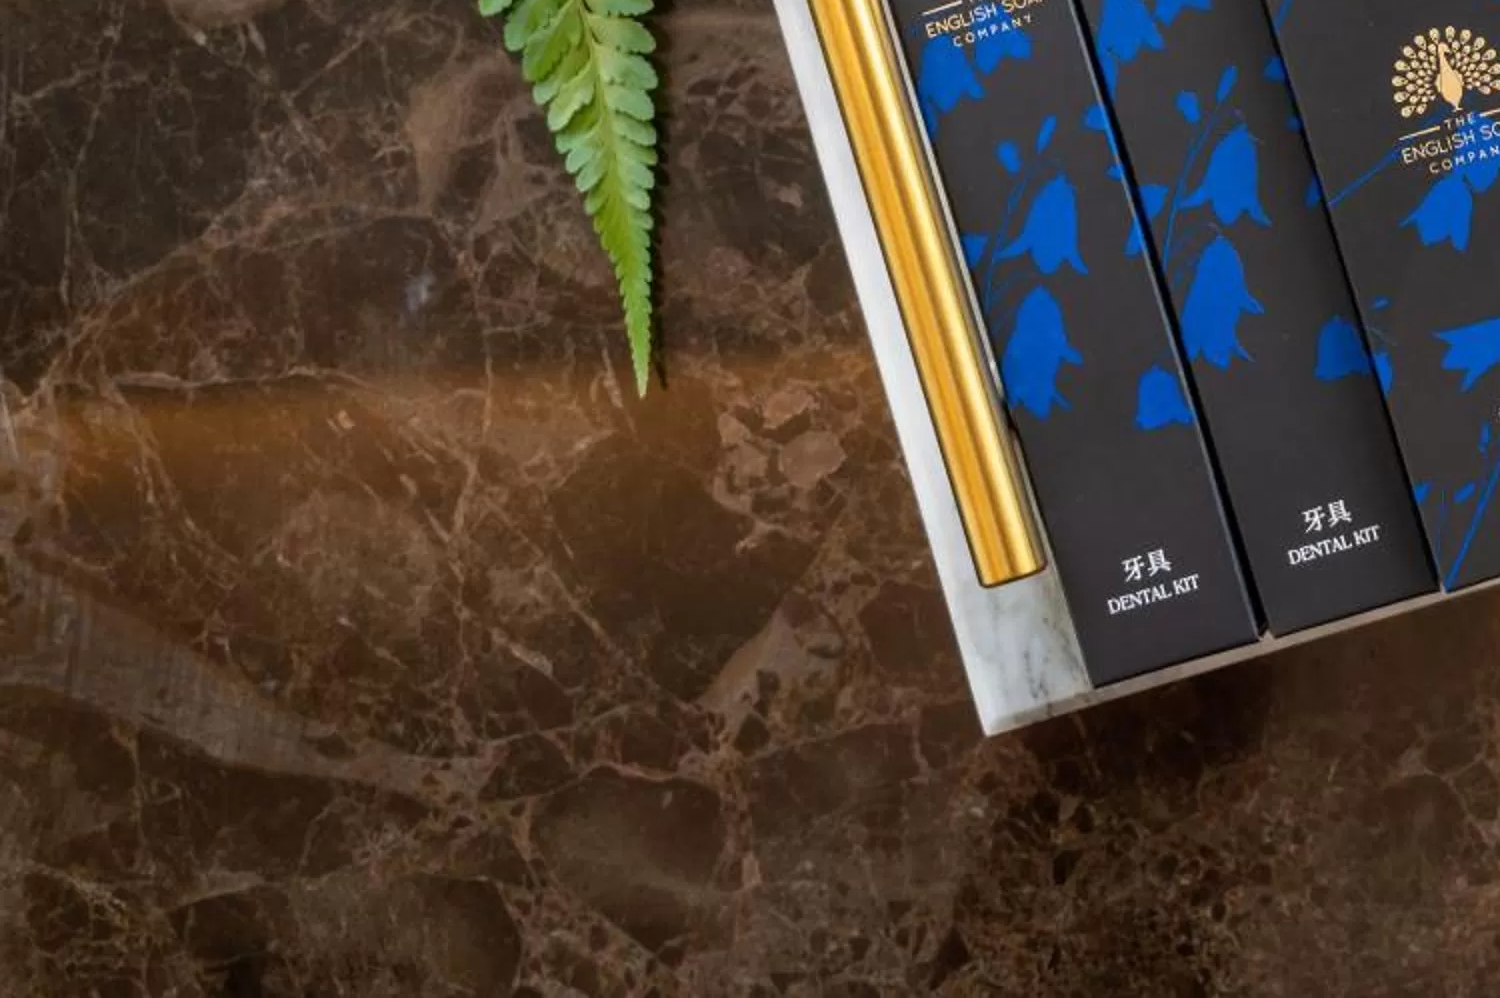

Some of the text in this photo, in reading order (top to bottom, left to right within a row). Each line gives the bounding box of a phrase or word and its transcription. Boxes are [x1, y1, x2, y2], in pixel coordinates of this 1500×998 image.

[925, 4, 997, 38] ENGLISH
[953, 13, 1032, 47] COMPANY
[1444, 112, 1476, 130] THE
[1402, 130, 1475, 164] ENGLISH
[1302, 499, 1352, 533] 牙具
[1288, 524, 1380, 565] DENTAL KIT
[1121, 549, 1171, 582] 牙具
[1107, 574, 1199, 614] DENTAL KIT
